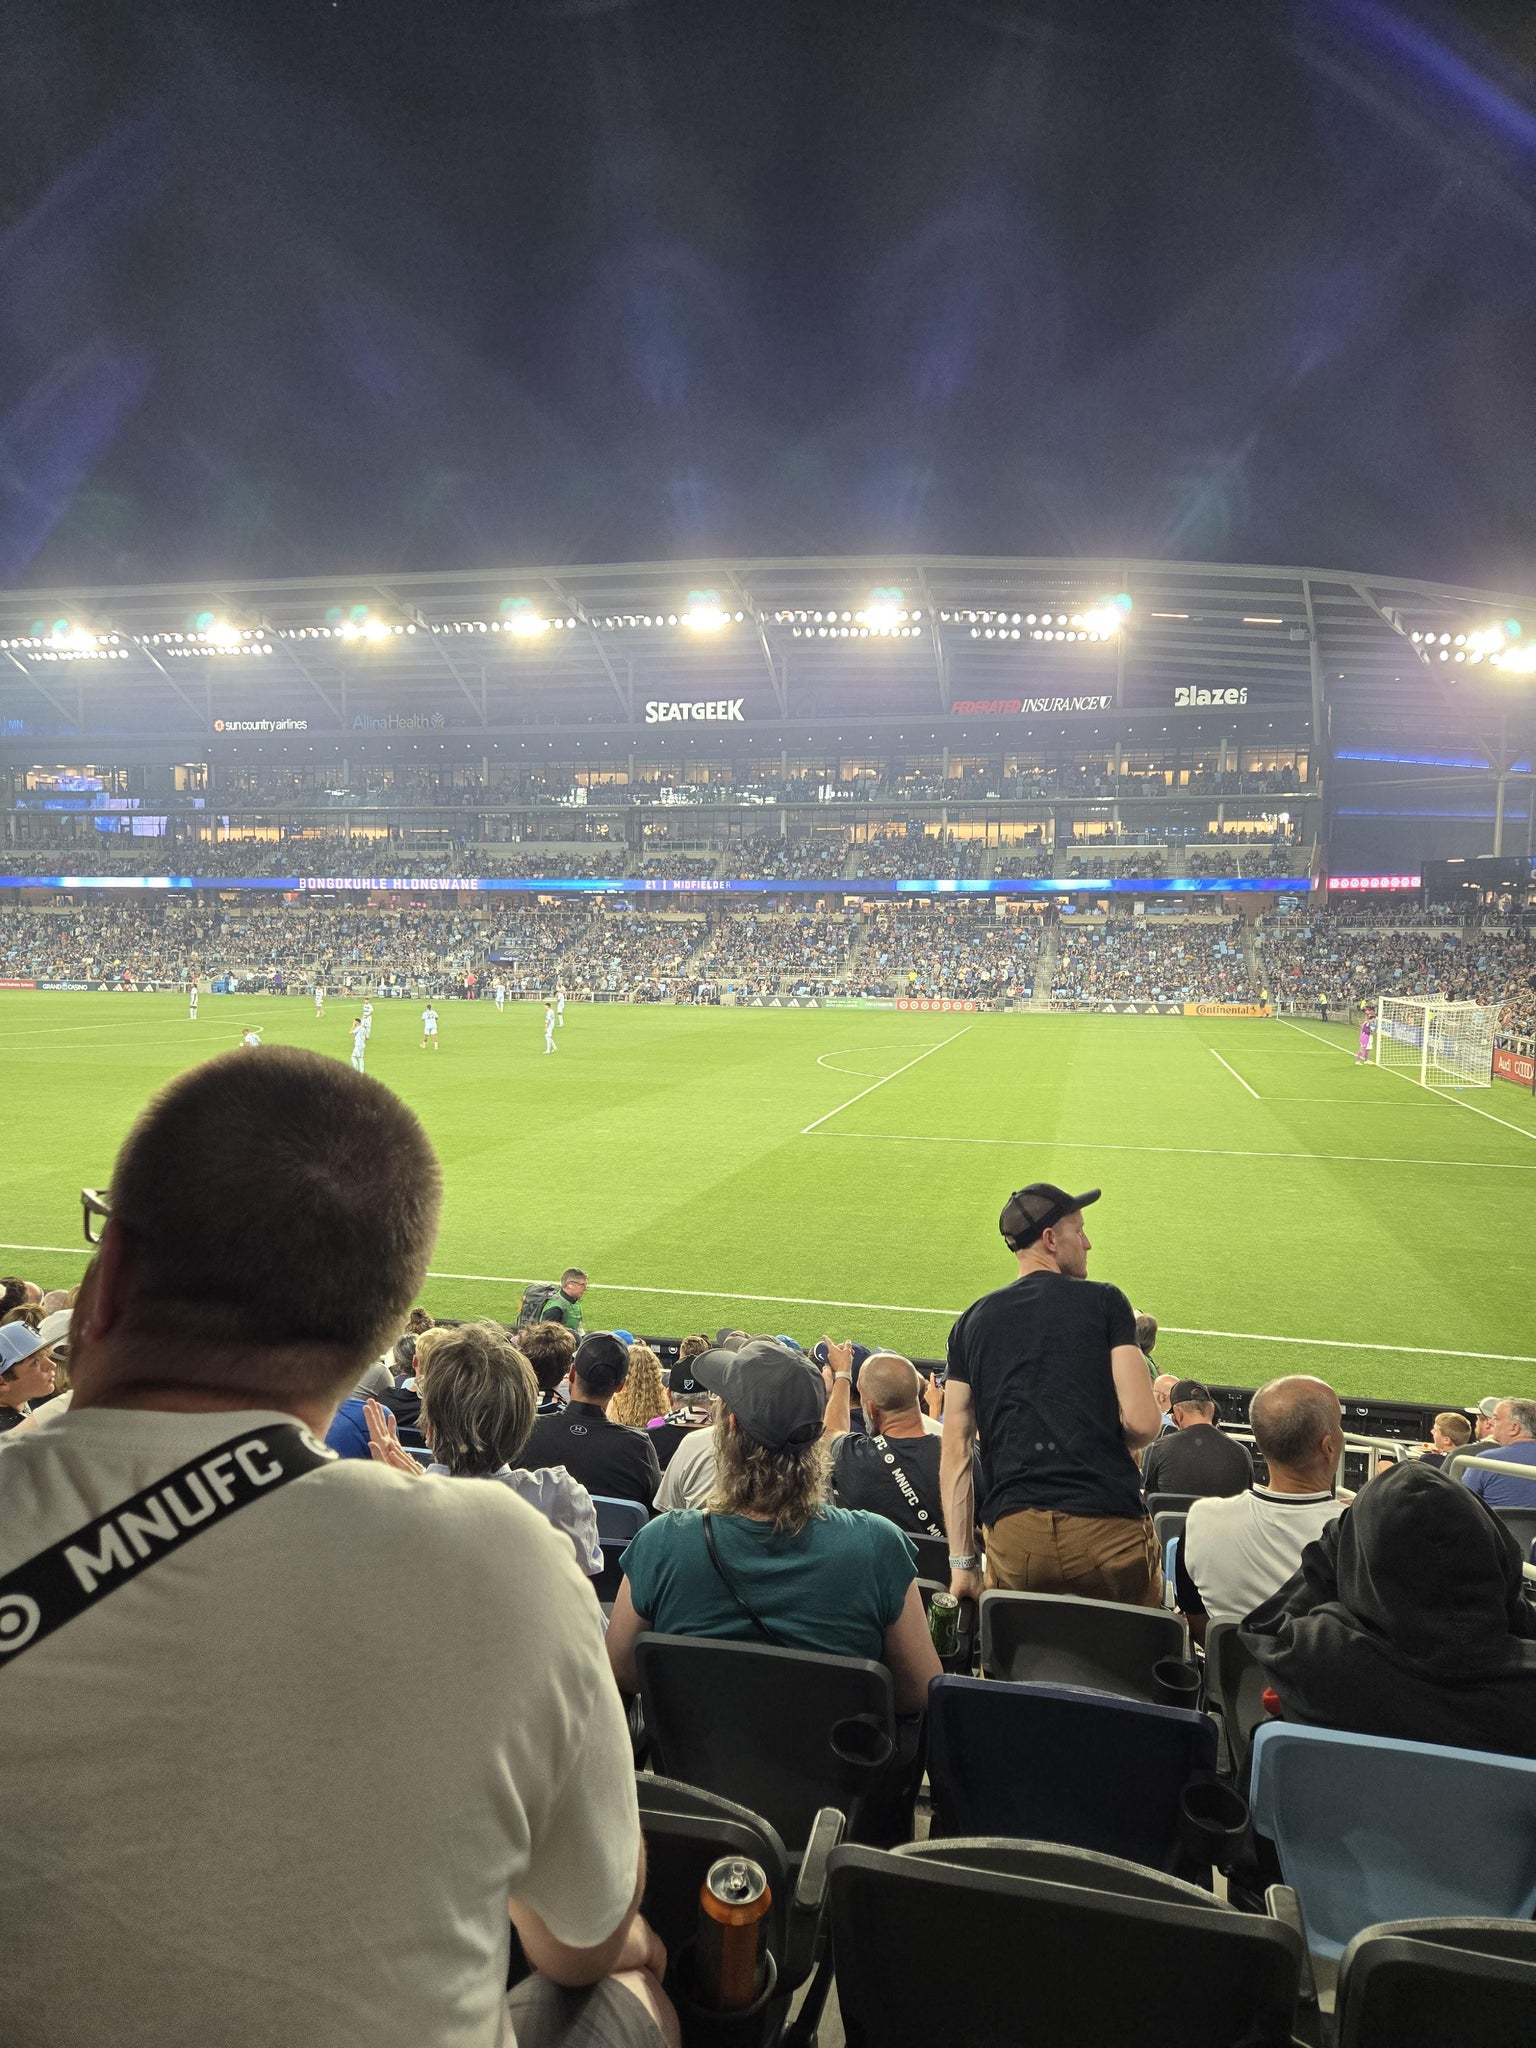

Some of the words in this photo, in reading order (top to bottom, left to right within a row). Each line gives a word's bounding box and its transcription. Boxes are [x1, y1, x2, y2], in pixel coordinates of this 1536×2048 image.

[1174, 686, 1239, 707] Blaze
[645, 698, 745, 723] SEATGEEK
[952, 700, 1021, 713] FEDERATED
[1021, 697, 1098, 713] INSURANCE
[225, 721, 241, 731] sun
[241, 719, 275, 732] country
[275, 719, 308, 730] airlines
[352, 714, 387, 729] Allina
[388, 713, 430, 729] Health
[299, 878, 387, 890] BONGOKUHLE
[393, 878, 479, 890] HLONGWANE
[673, 880, 732, 890] MIDFIELDER
[1196, 1004, 1249, 1016] Continental
[1498, 1056, 1511, 1072] Audi
[892, 1468, 919, 1506] MNUFC
[64, 1439, 283, 1593] MNUFC
